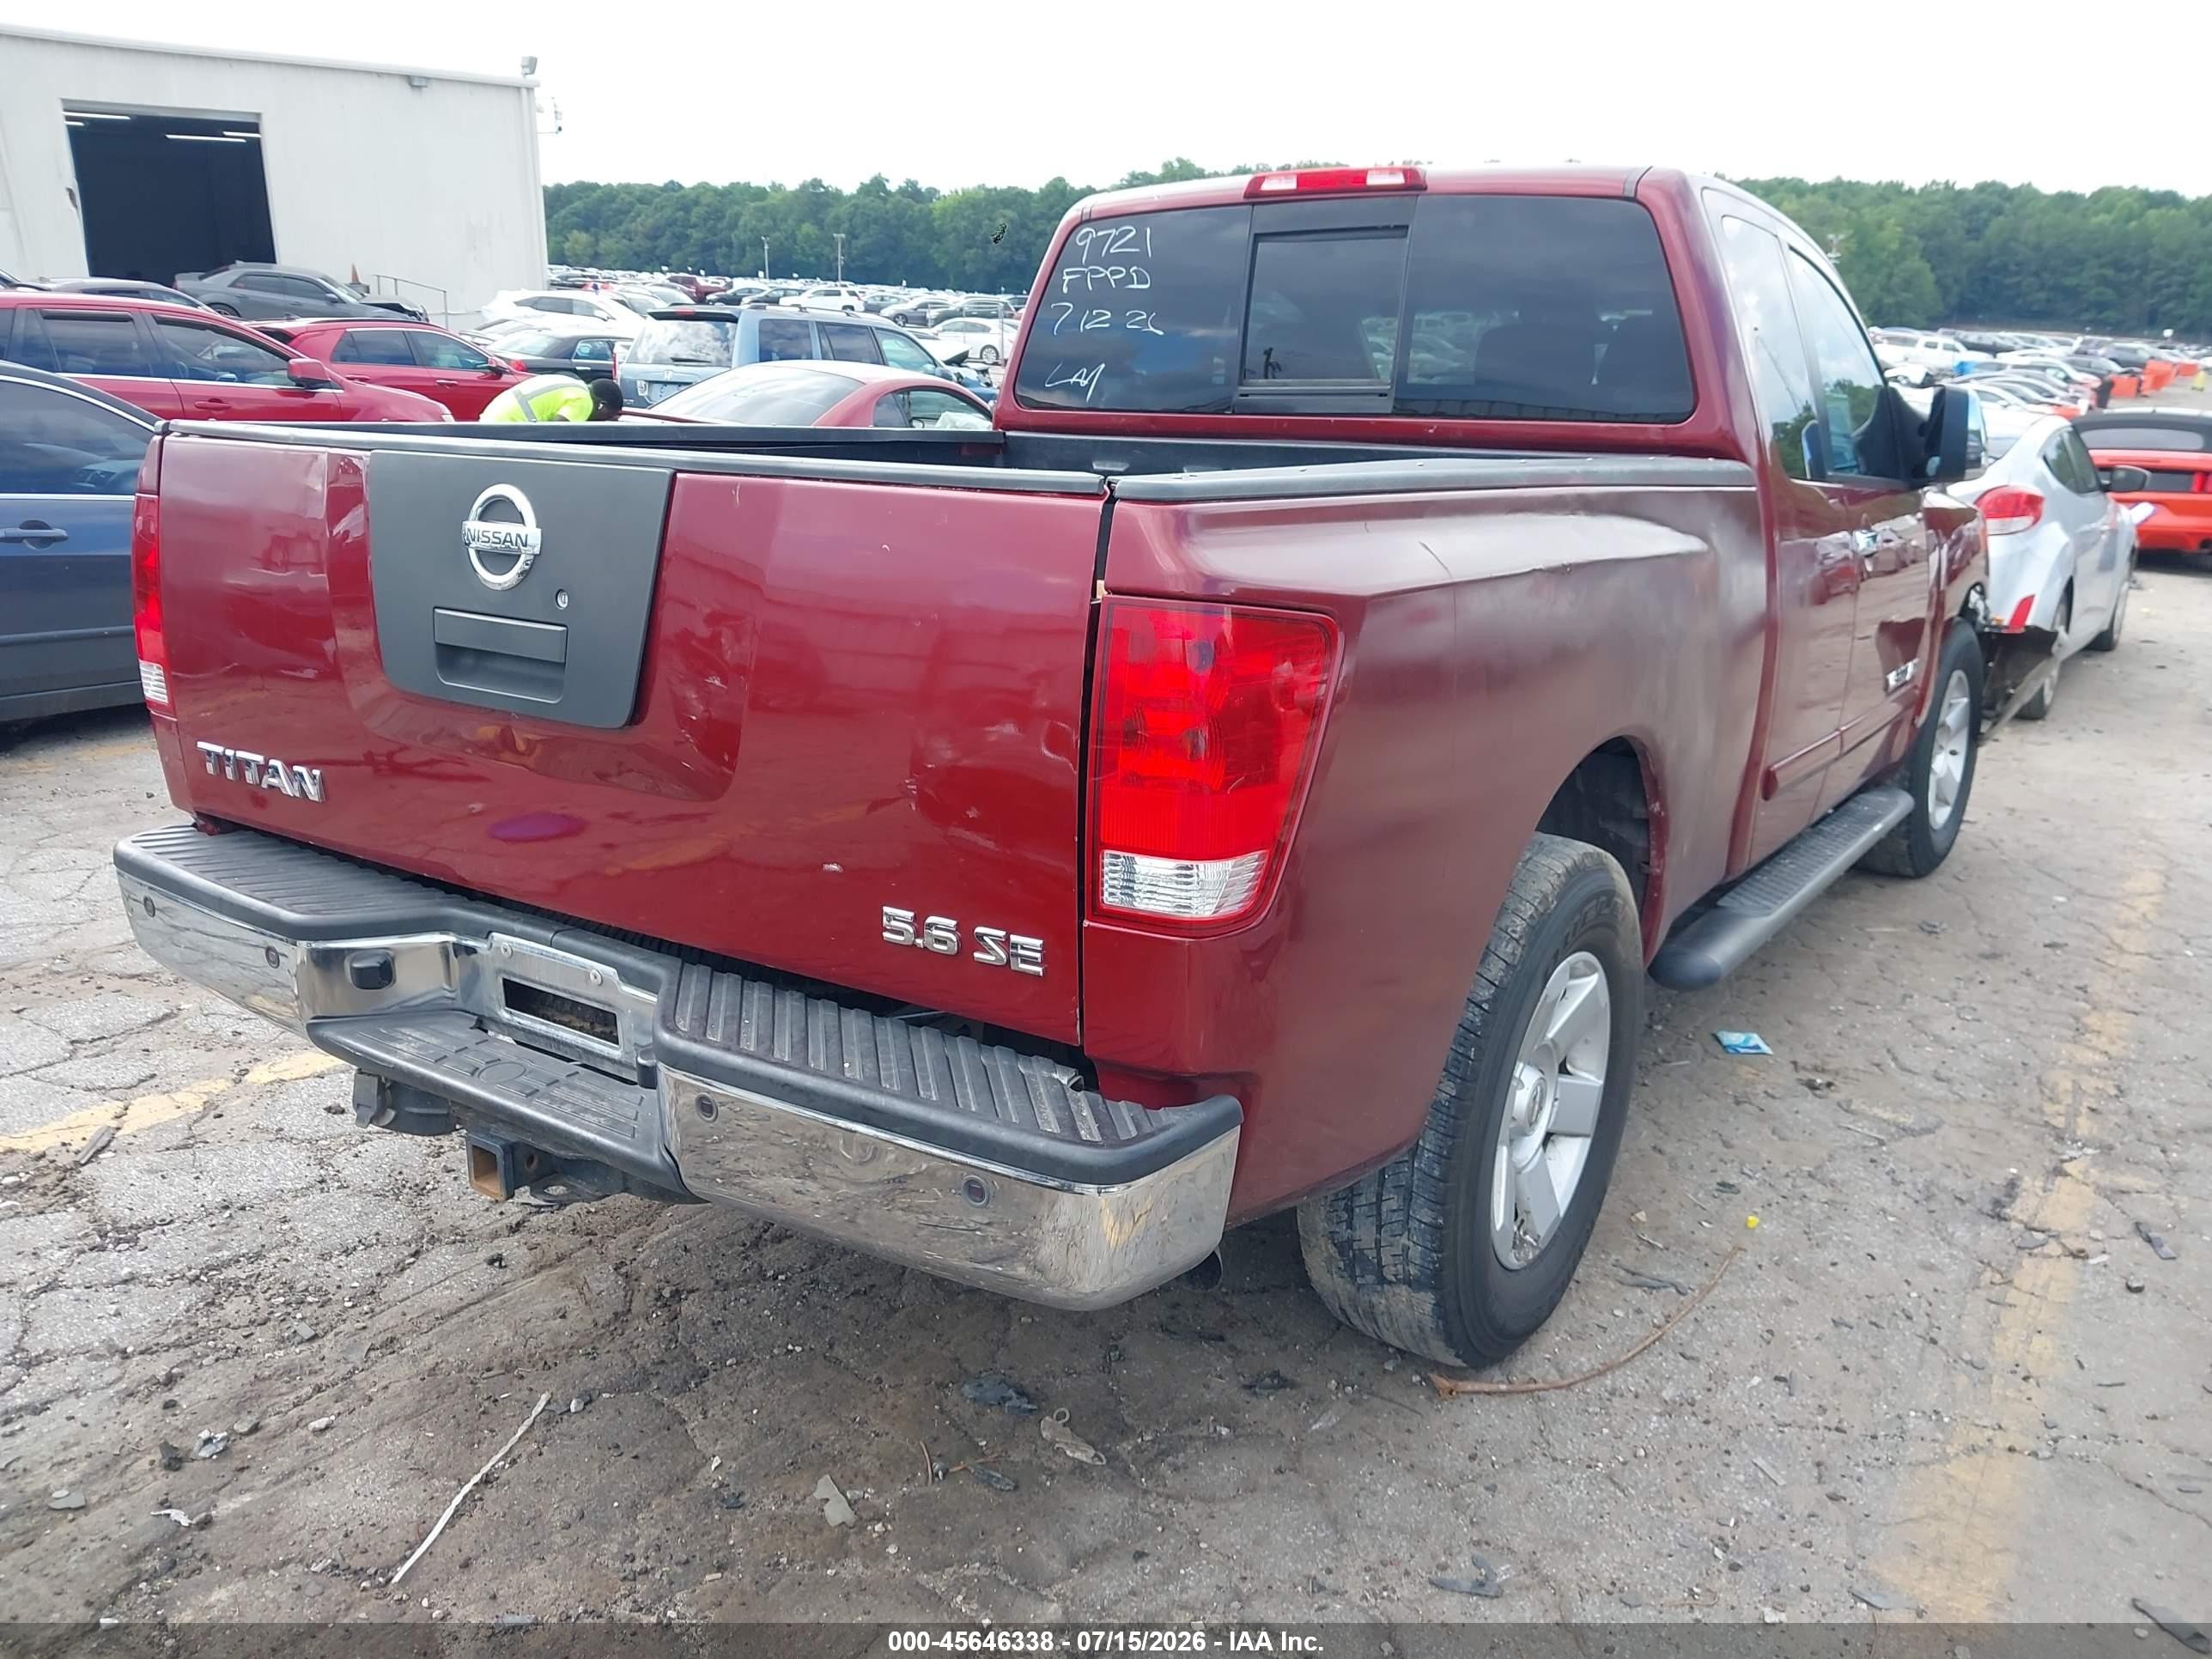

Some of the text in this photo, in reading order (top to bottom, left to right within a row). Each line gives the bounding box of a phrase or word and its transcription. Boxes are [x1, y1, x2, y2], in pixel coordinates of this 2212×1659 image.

[1075, 226, 1152, 265] 9721
[1061, 266, 1151, 294] FPPD
[466, 527, 529, 548] NISSAN
[196, 741, 326, 803] TITAN
[882, 906, 1047, 977] 5.6 SE
